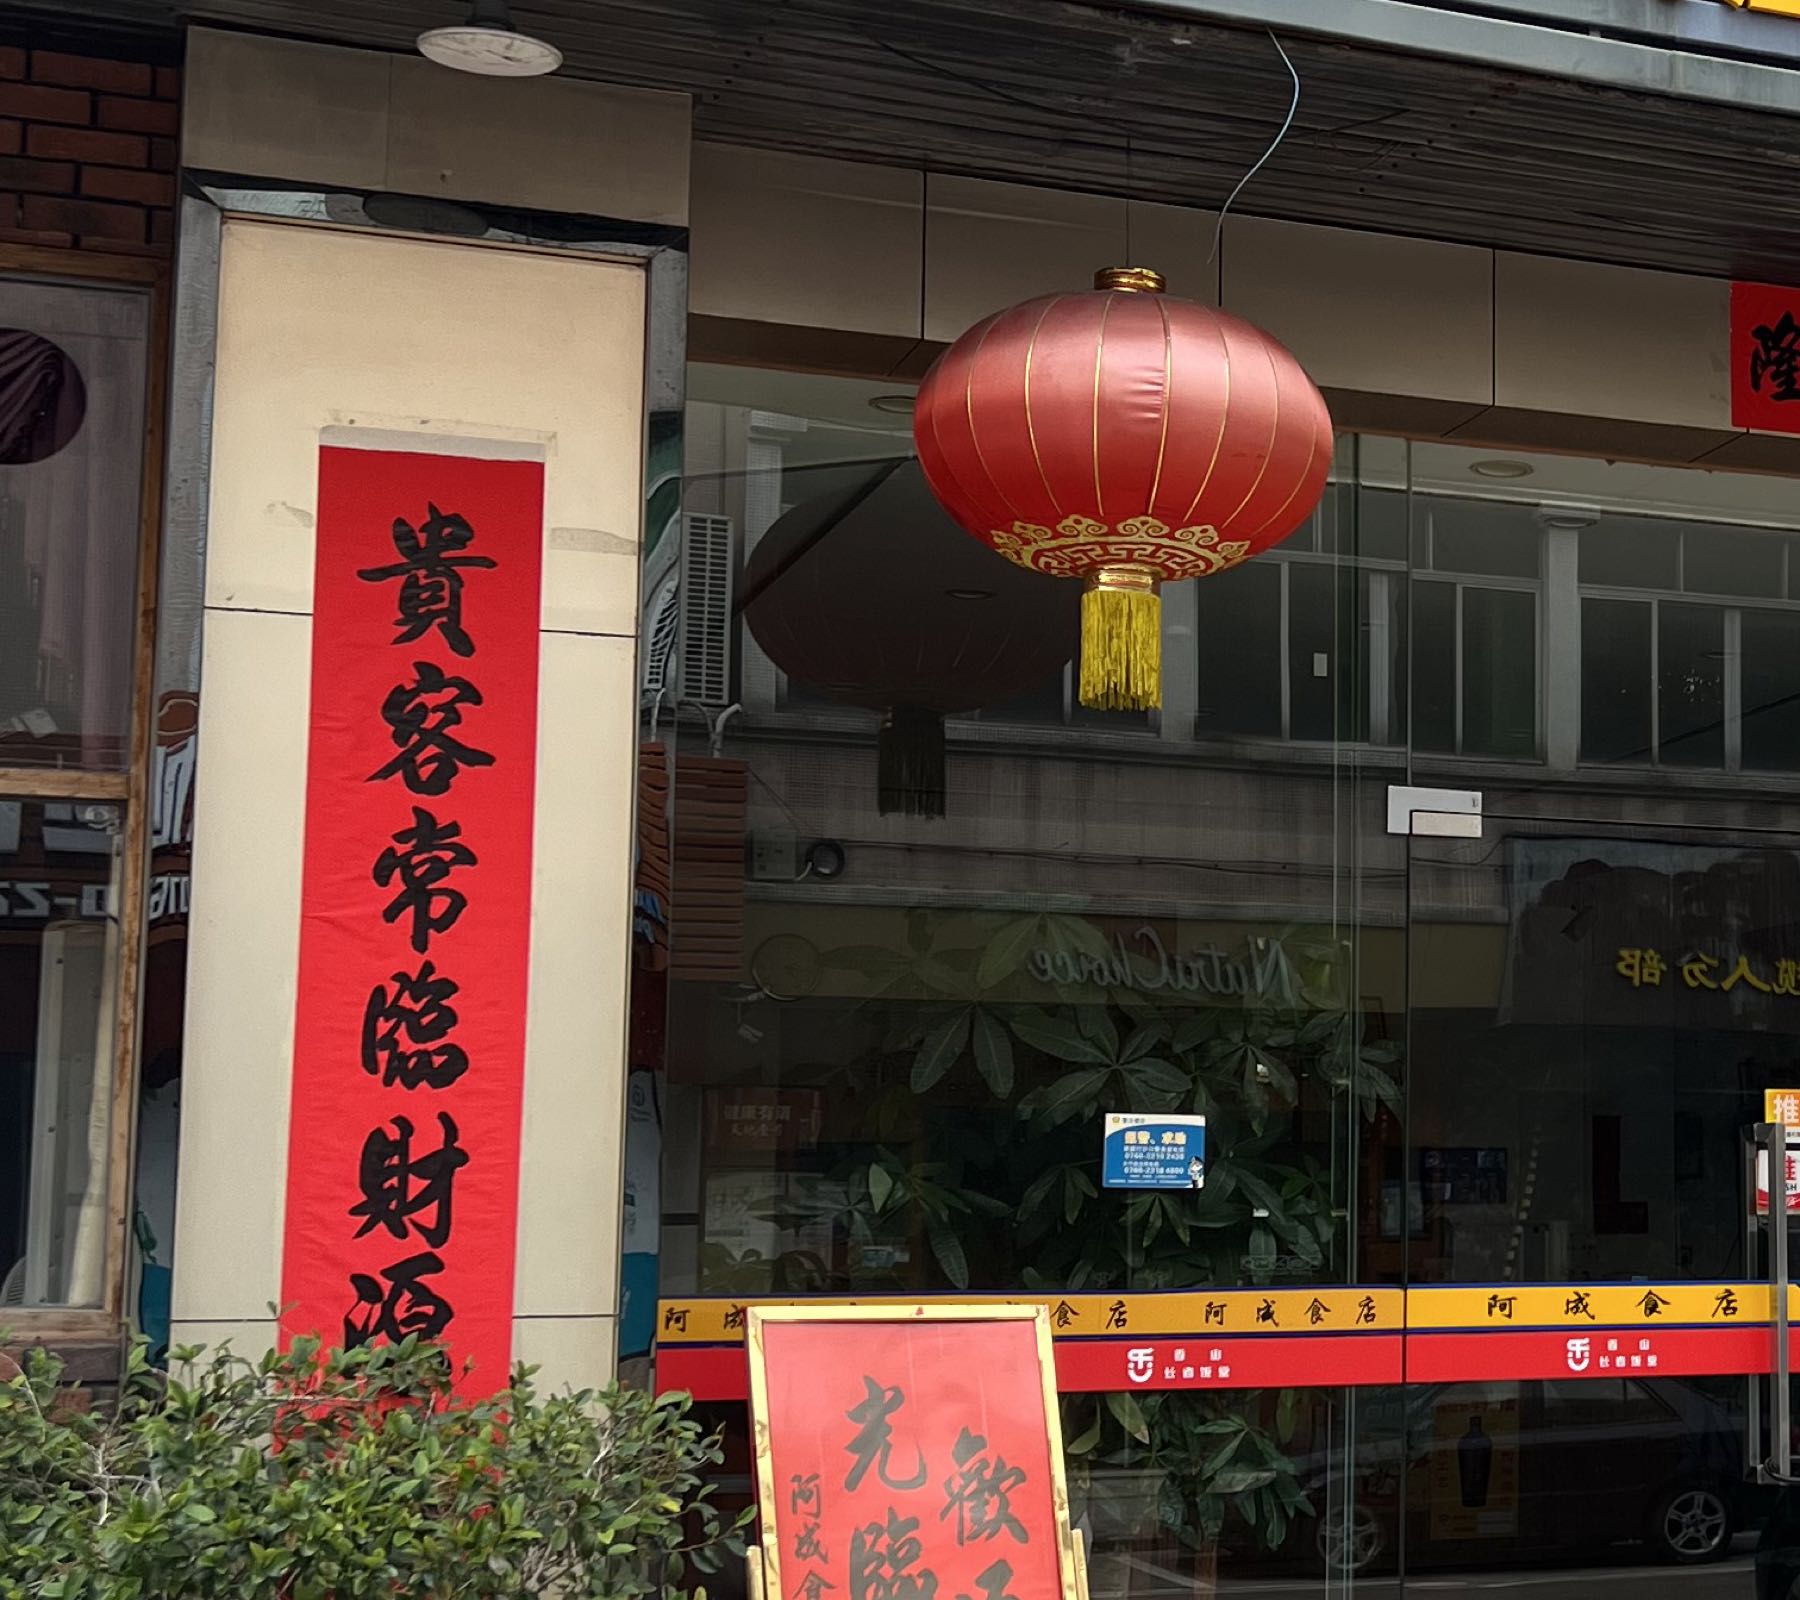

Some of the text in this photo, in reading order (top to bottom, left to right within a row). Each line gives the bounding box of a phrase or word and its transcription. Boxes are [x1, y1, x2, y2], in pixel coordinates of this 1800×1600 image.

[1773, 1093, 1799, 1123] 推
[1488, 1289, 1738, 1319] 阿成食店
